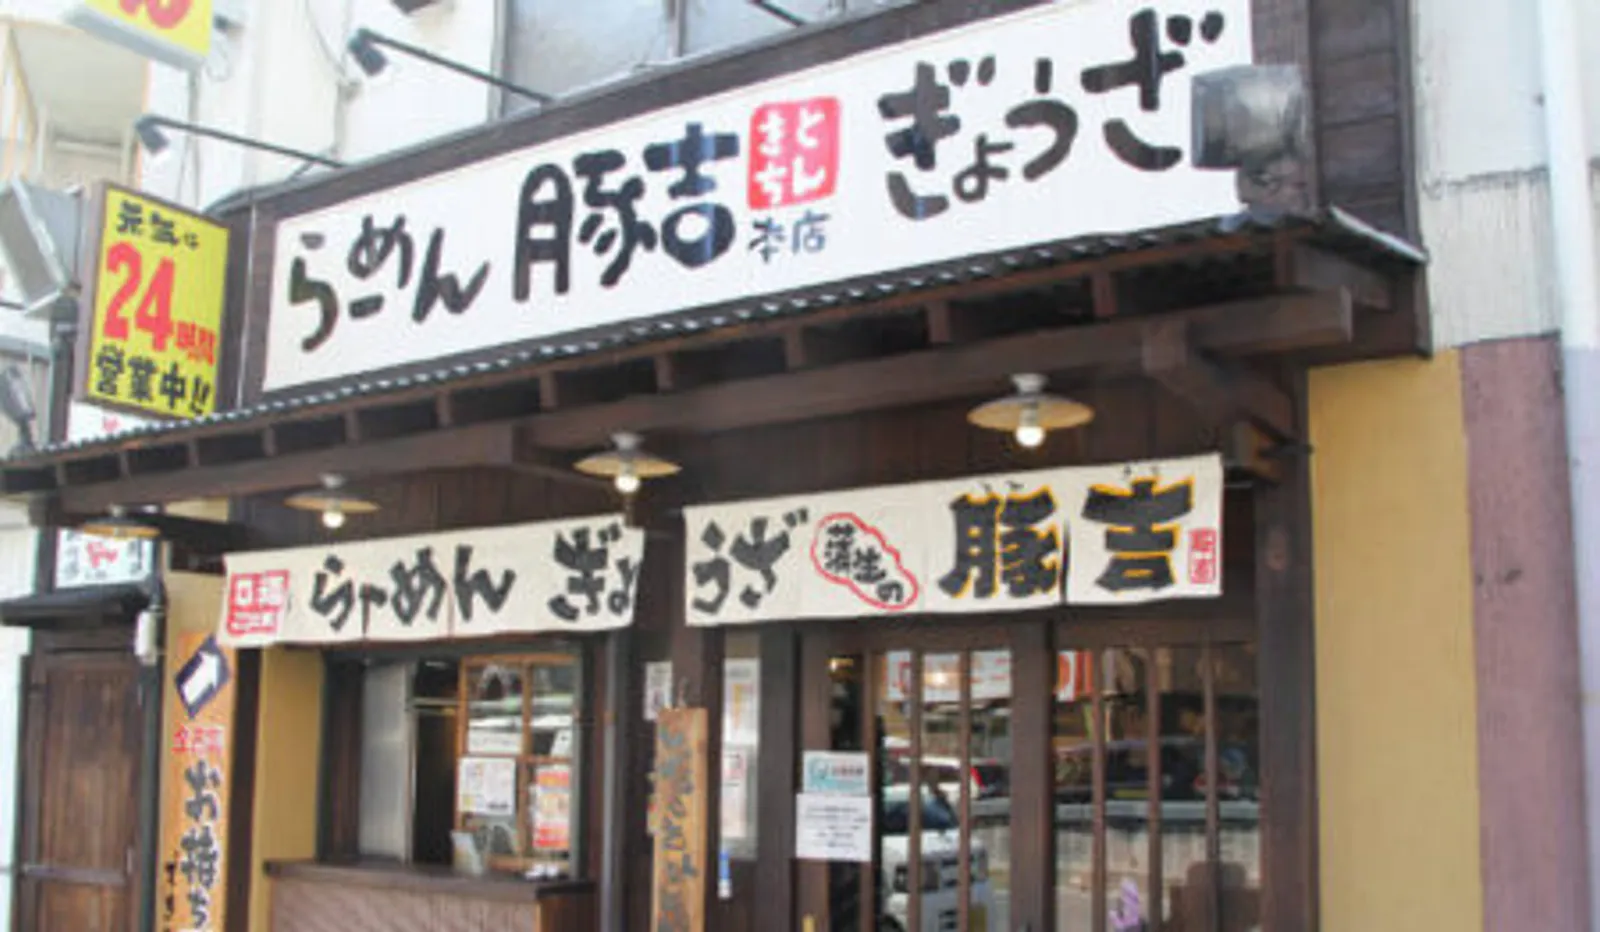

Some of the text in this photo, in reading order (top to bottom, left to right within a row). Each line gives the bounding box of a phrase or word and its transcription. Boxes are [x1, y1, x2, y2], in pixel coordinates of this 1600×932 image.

[288, 8, 1224, 352] らーめん 豚吉 ぎょうざ
[754, 110, 787, 206] きち
[792, 106, 826, 197] とん
[748, 209, 830, 264] 本店
[310, 545, 516, 633] らーめん
[546, 522, 640, 621] ぎょ
[691, 508, 809, 615] うざ
[824, 522, 905, 604] 蒲生の
[938, 478, 1194, 600] 豚吉
[180, 759, 222, 930] お持ち
